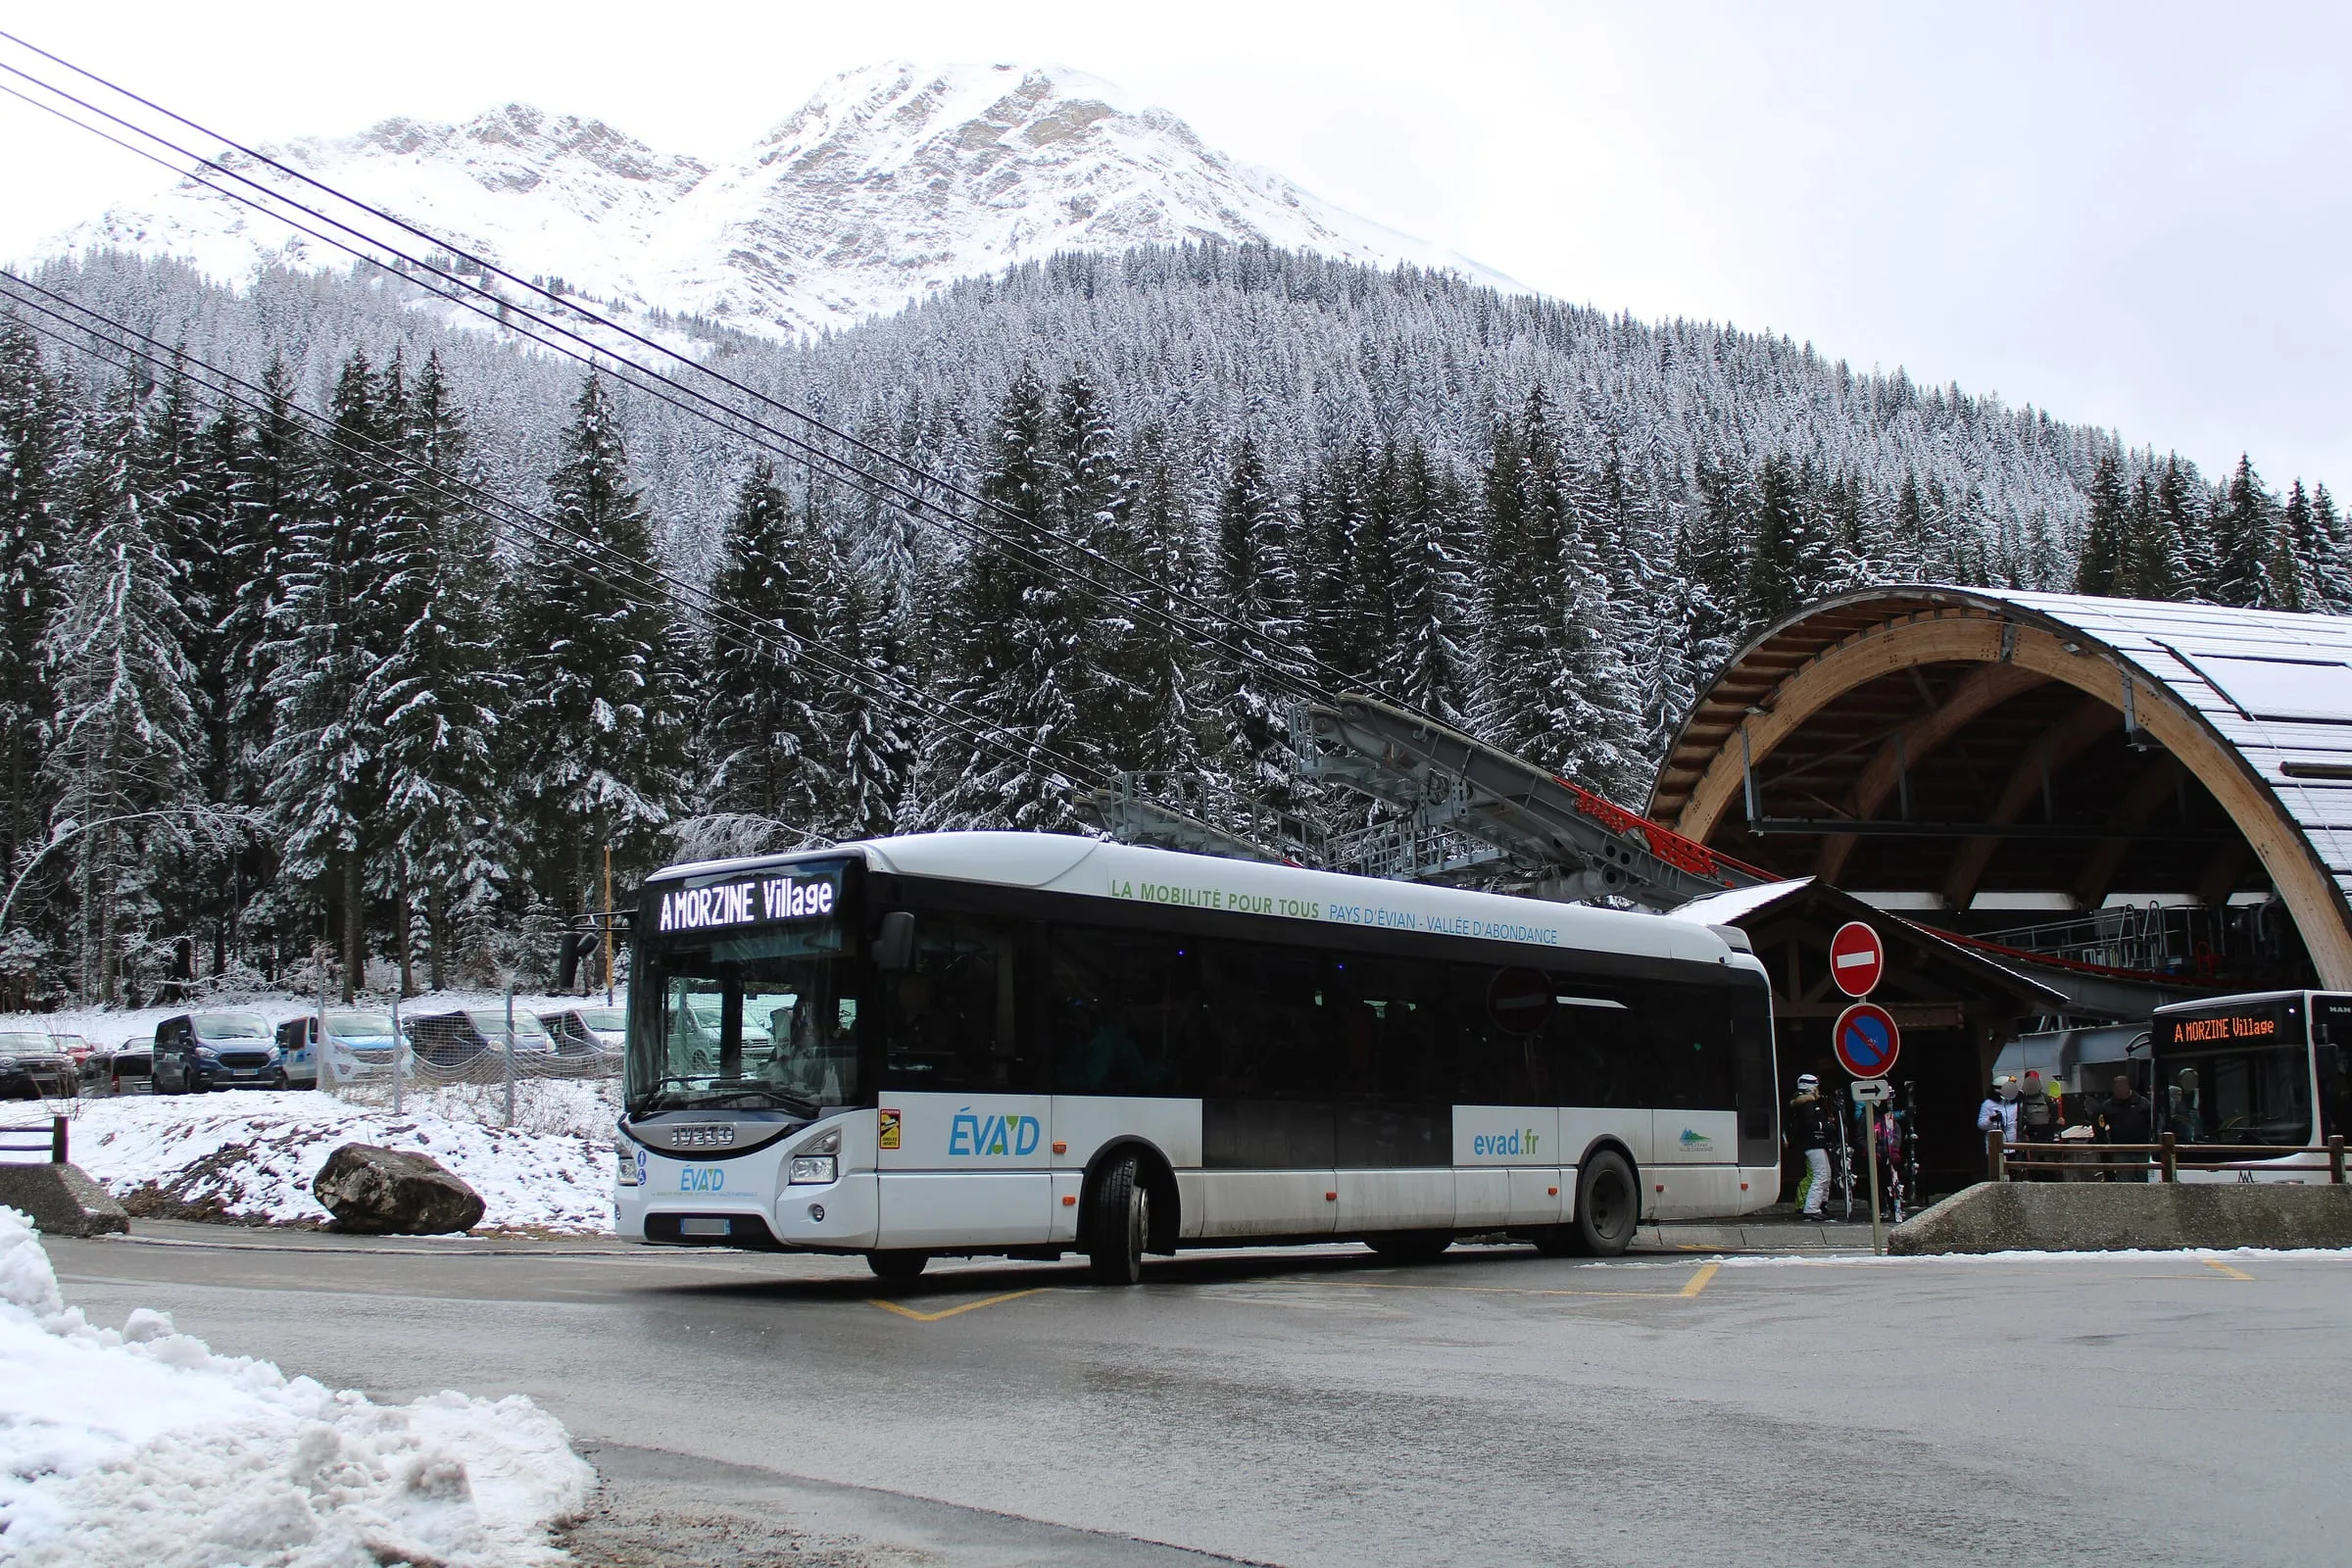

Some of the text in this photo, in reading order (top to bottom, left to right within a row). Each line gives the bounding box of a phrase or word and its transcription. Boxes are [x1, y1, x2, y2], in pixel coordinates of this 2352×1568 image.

[660, 877, 832, 931] A MORZINE Village
[1111, 879, 1133, 899] LA
[1141, 883, 1221, 907] MOBILITÉ
[1228, 893, 1272, 914] POUR
[1279, 899, 1319, 918] TOUS
[1330, 904, 1360, 923] PAYS
[1364, 907, 1415, 929] D'ÉVIAN
[1427, 916, 1469, 935] VALLÉE
[1473, 921, 1557, 945] D'ABONDANCE
[2175, 1016, 2275, 1043] A MORZINE Village
[671, 1125, 735, 1147] IVECO
[1473, 1129, 1540, 1155] evad.fr
